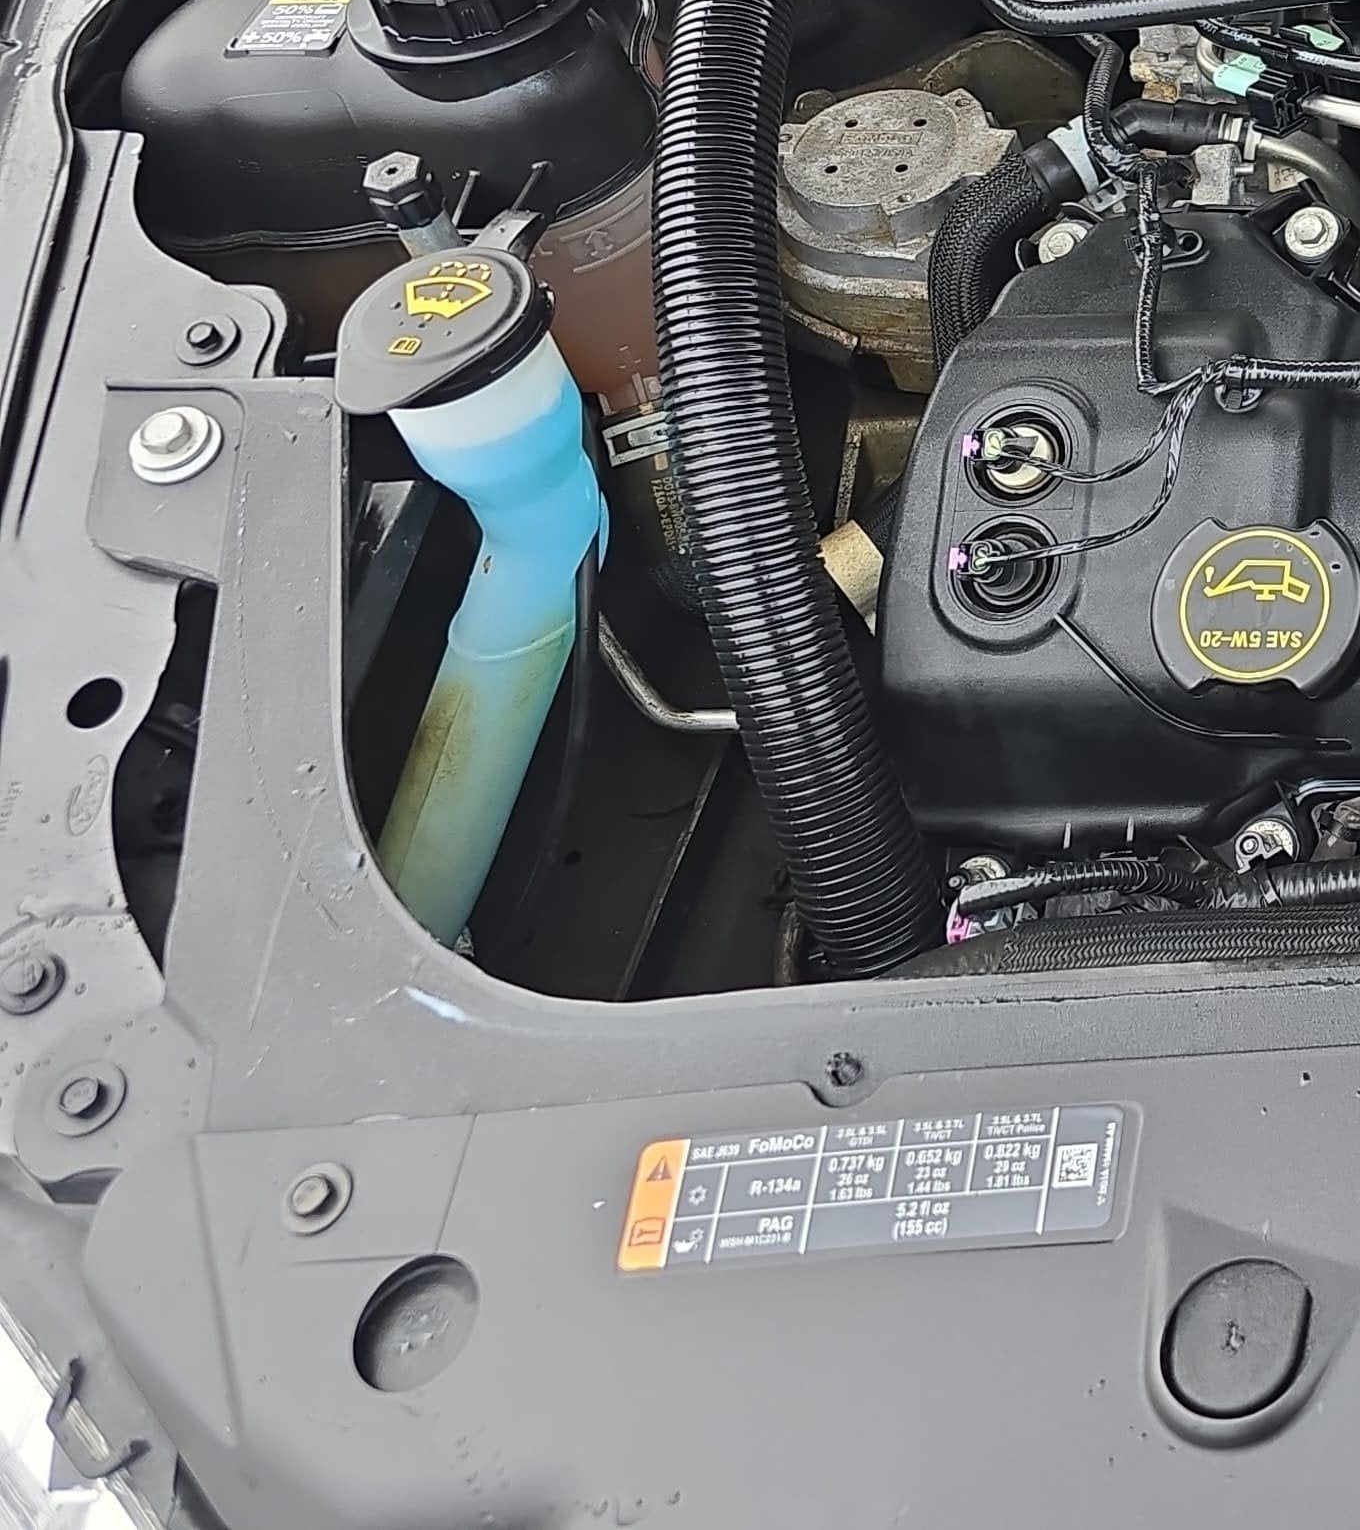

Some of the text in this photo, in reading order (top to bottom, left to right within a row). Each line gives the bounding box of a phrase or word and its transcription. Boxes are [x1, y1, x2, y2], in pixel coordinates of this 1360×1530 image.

[272, 4, 315, 15] 50%
[1199, 629, 1304, 649] SAE 5W-20
[1016, 1122, 1047, 1135] Police
[690, 1147, 713, 1161] SAE
[748, 1134, 816, 1156] FoMoCo
[1022, 1141, 1043, 1160] kg
[828, 1153, 886, 1173] 0.737 kg
[905, 1147, 963, 1167] 0.652 kg
[1010, 1160, 1027, 1172] oz
[837, 1172, 870, 1187] 26 oz
[914, 1166, 948, 1181] 23 oz
[1010, 1173, 1031, 1187] lbs
[749, 1178, 802, 1197] R-134a
[829, 1186, 874, 1202] 1.63 lbs
[906, 1180, 952, 1195] 1.44 lbs
[895, 1200, 951, 1218] 5.2 fl oz
[758, 1215, 794, 1233] PAG
[892, 1216, 949, 1242] (155 cc)
